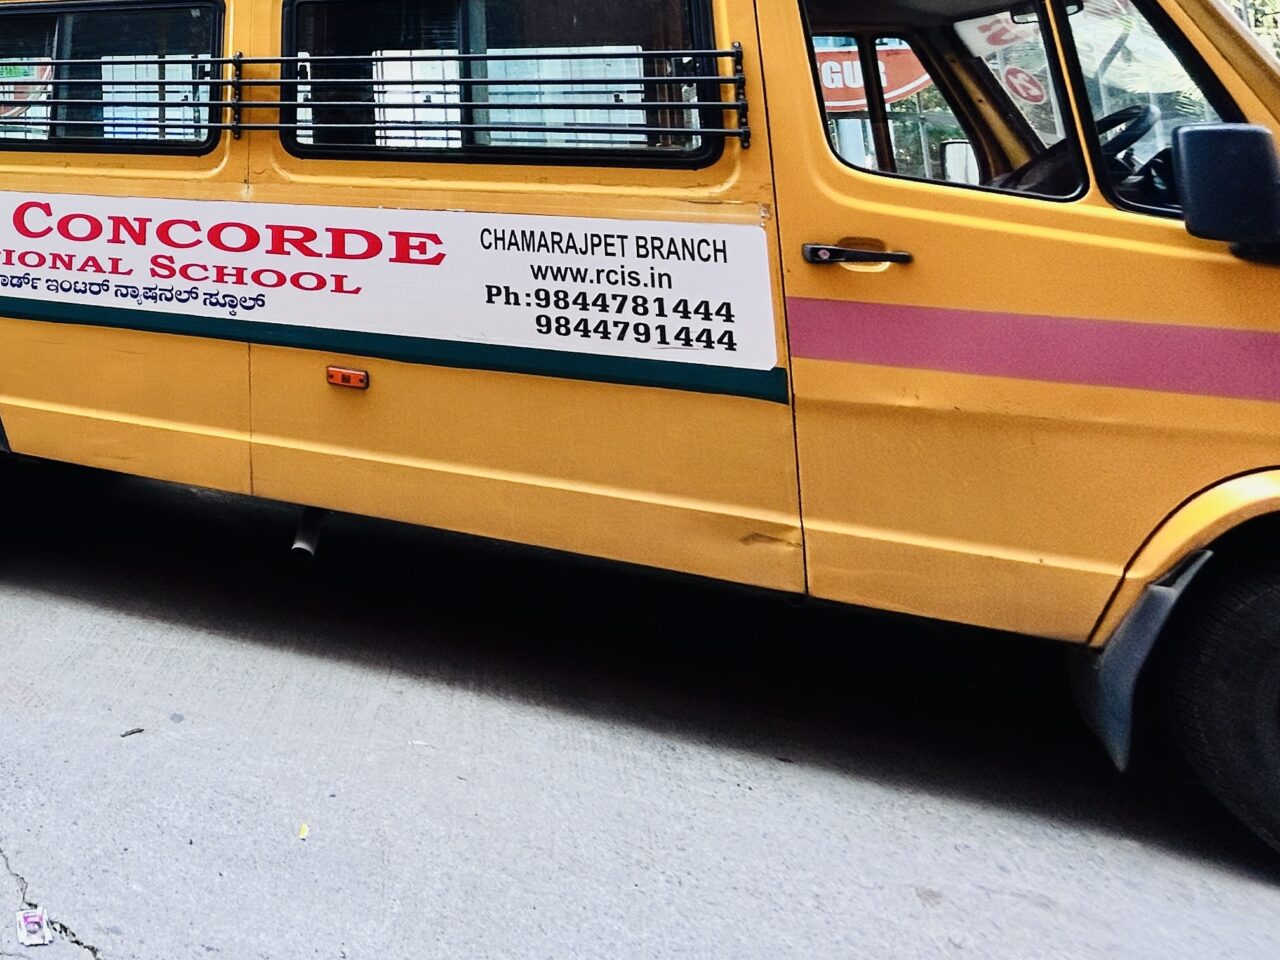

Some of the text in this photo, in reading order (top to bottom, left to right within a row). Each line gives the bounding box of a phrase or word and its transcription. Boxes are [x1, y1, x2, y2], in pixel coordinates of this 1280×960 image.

[12, 201, 447, 266] CONCORDE
[480, 228, 728, 263] CHAMARAJPET BRANCH
[45, 278, 110, 296] ಇಂಟರ್
[150, 254, 362, 295] SCHOOL
[530, 264, 673, 289] www.rcis.in
[535, 314, 738, 352] 9844791444
